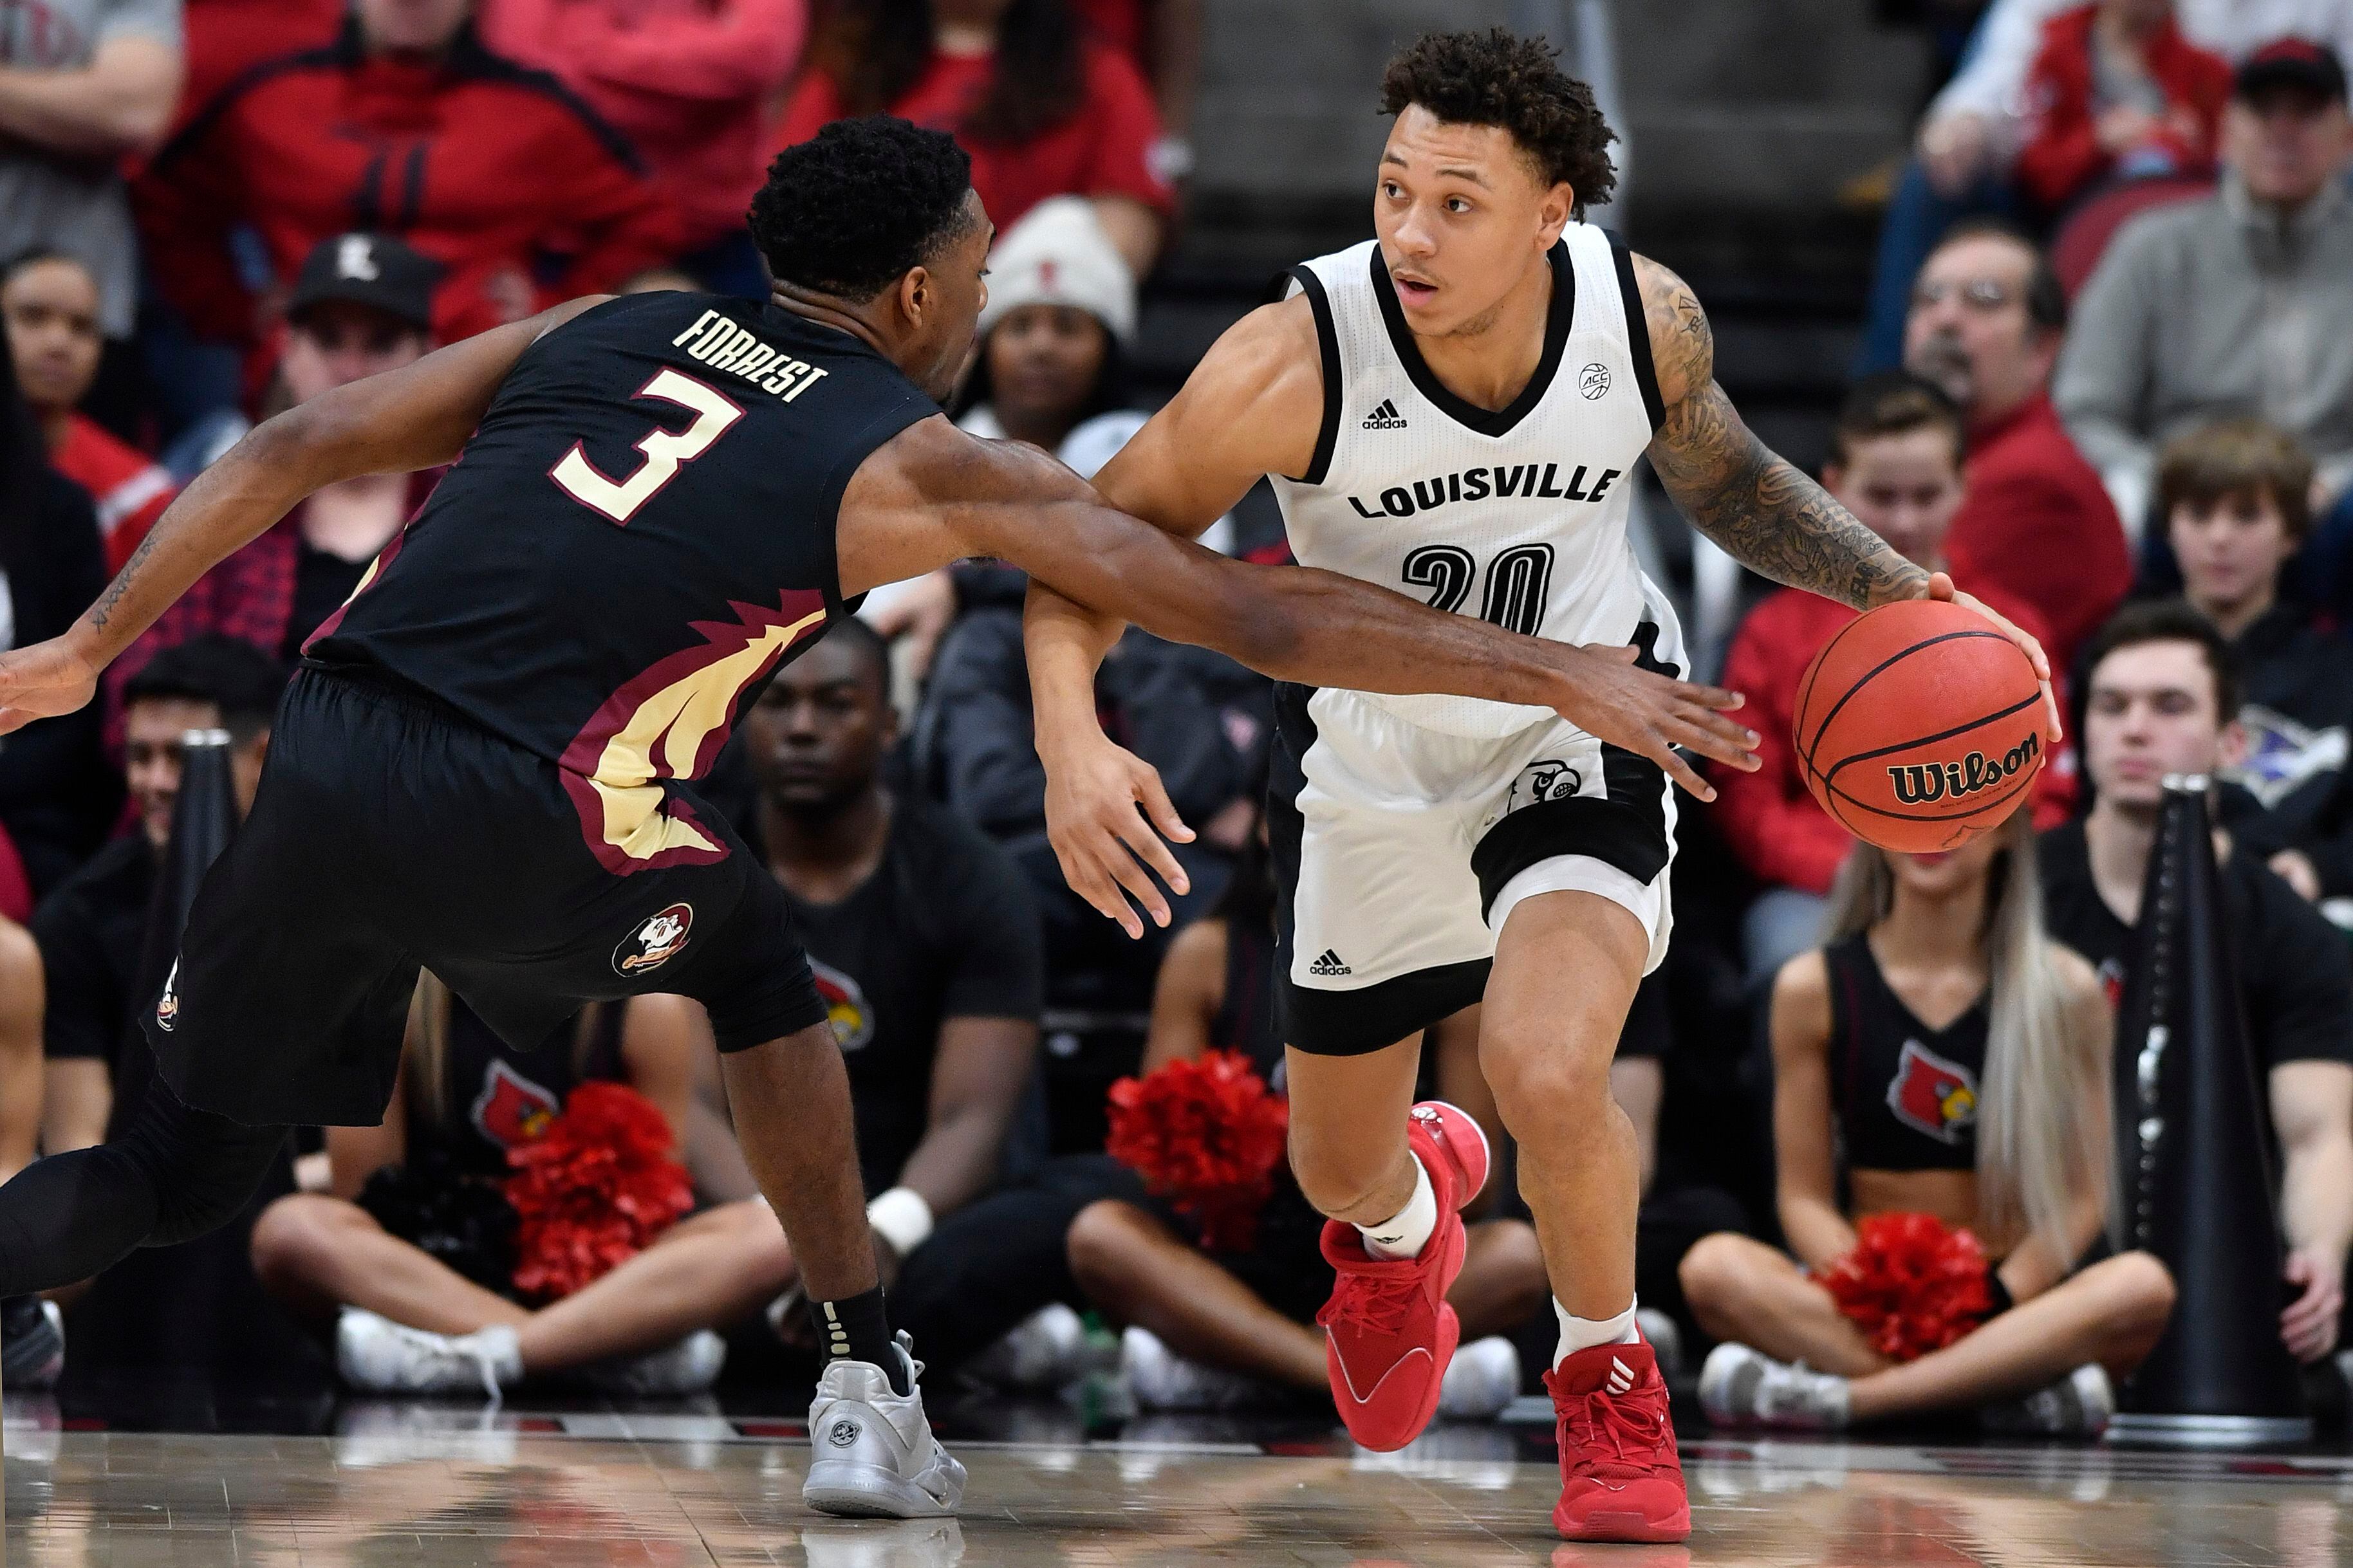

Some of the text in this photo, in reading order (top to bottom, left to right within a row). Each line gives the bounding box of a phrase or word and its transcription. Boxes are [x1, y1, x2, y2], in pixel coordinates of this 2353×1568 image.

[672, 309, 829, 403] FORREST
[1583, 372, 1608, 387] ACC
[546, 365, 748, 526] 3
[1362, 418, 1408, 430] adidas
[1348, 463, 1621, 519] LOUISVILLE
[1402, 543, 1555, 637] 20
[1886, 731, 2039, 805] Wilson
[1309, 965, 1352, 975] adidas
